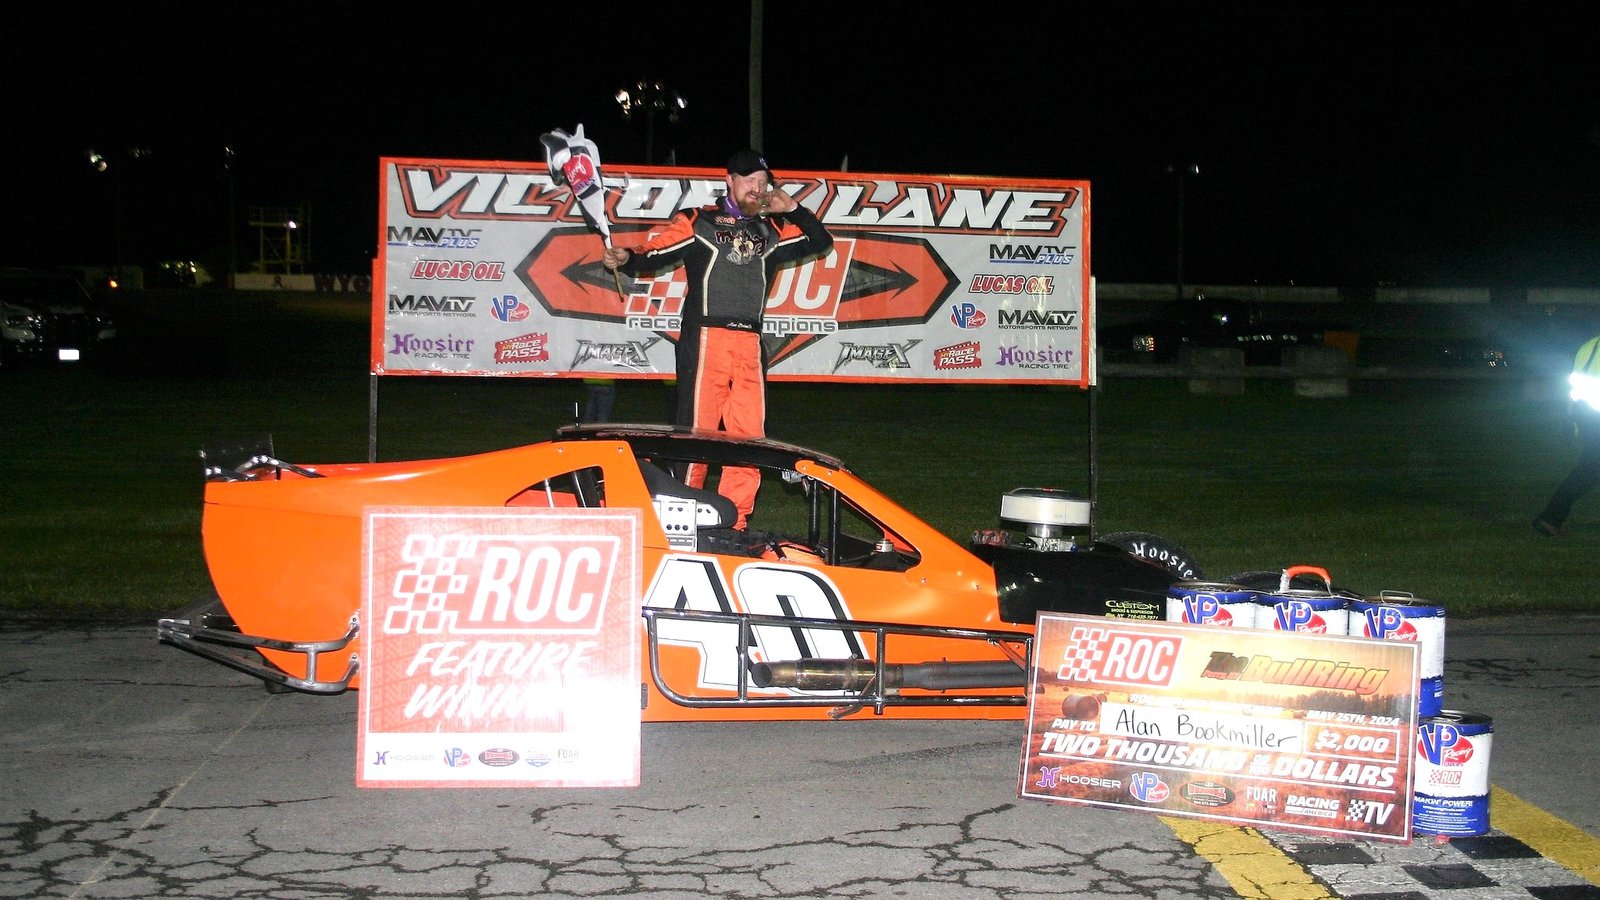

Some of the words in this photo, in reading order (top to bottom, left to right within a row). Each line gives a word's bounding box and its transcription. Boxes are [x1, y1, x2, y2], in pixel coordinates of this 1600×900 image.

[824, 183, 1066, 231] LANE
[388, 226, 482, 243] MAVTV
[438, 237, 480, 249] PLUS
[990, 244, 1076, 260] MAVTV
[1036, 254, 1074, 264] PLUS
[411, 260, 473, 280] LUCAS
[474, 262, 504, 281] OIL
[969, 274, 1026, 294] LUCAS
[1026, 275, 1054, 294] OIL
[389, 294, 477, 312] MAVTV
[492, 295, 518, 322] VP
[628, 317, 681, 328] race
[951, 302, 975, 329] VP
[998, 309, 1077, 325] MAVTV
[389, 333, 475, 355] Hoosier
[501, 346, 542, 359] PASS
[940, 354, 975, 366] PASS
[995, 345, 1073, 366] Hoosier
[1132, 542, 1197, 579] Hoosie
[468, 546, 602, 622] ROC
[1183, 594, 1219, 624] VP
[1275, 600, 1312, 631] VP
[642, 553, 870, 698] 40
[1364, 606, 1402, 639] VP
[406, 640, 598, 678] FEATURE
[1102, 636, 1174, 682] ROC
[1239, 655, 1390, 695] BullRing
[1052, 718, 1078, 730] PAY
[1079, 720, 1096, 732] TO
[1307, 709, 1334, 721] MAY
[1369, 715, 1399, 726] 2024
[1115, 709, 1161, 736] Alan
[1177, 714, 1298, 748] Bookmiller
[1314, 729, 1390, 753] $2,000
[1418, 723, 1458, 765] VP
[1444, 747, 1474, 761] Racing
[444, 747, 463, 767] VP
[1040, 731, 1102, 756] TWO
[1103, 737, 1249, 771] THOUSAND
[1272, 755, 1398, 788] DOLLARS
[1059, 774, 1122, 789] HOOSIER
[1131, 772, 1159, 801] VP
[1440, 771, 1462, 784] ROC
[1247, 786, 1277, 802] FOAR
[1287, 794, 1340, 810] RACING
[1364, 801, 1395, 825] TV
